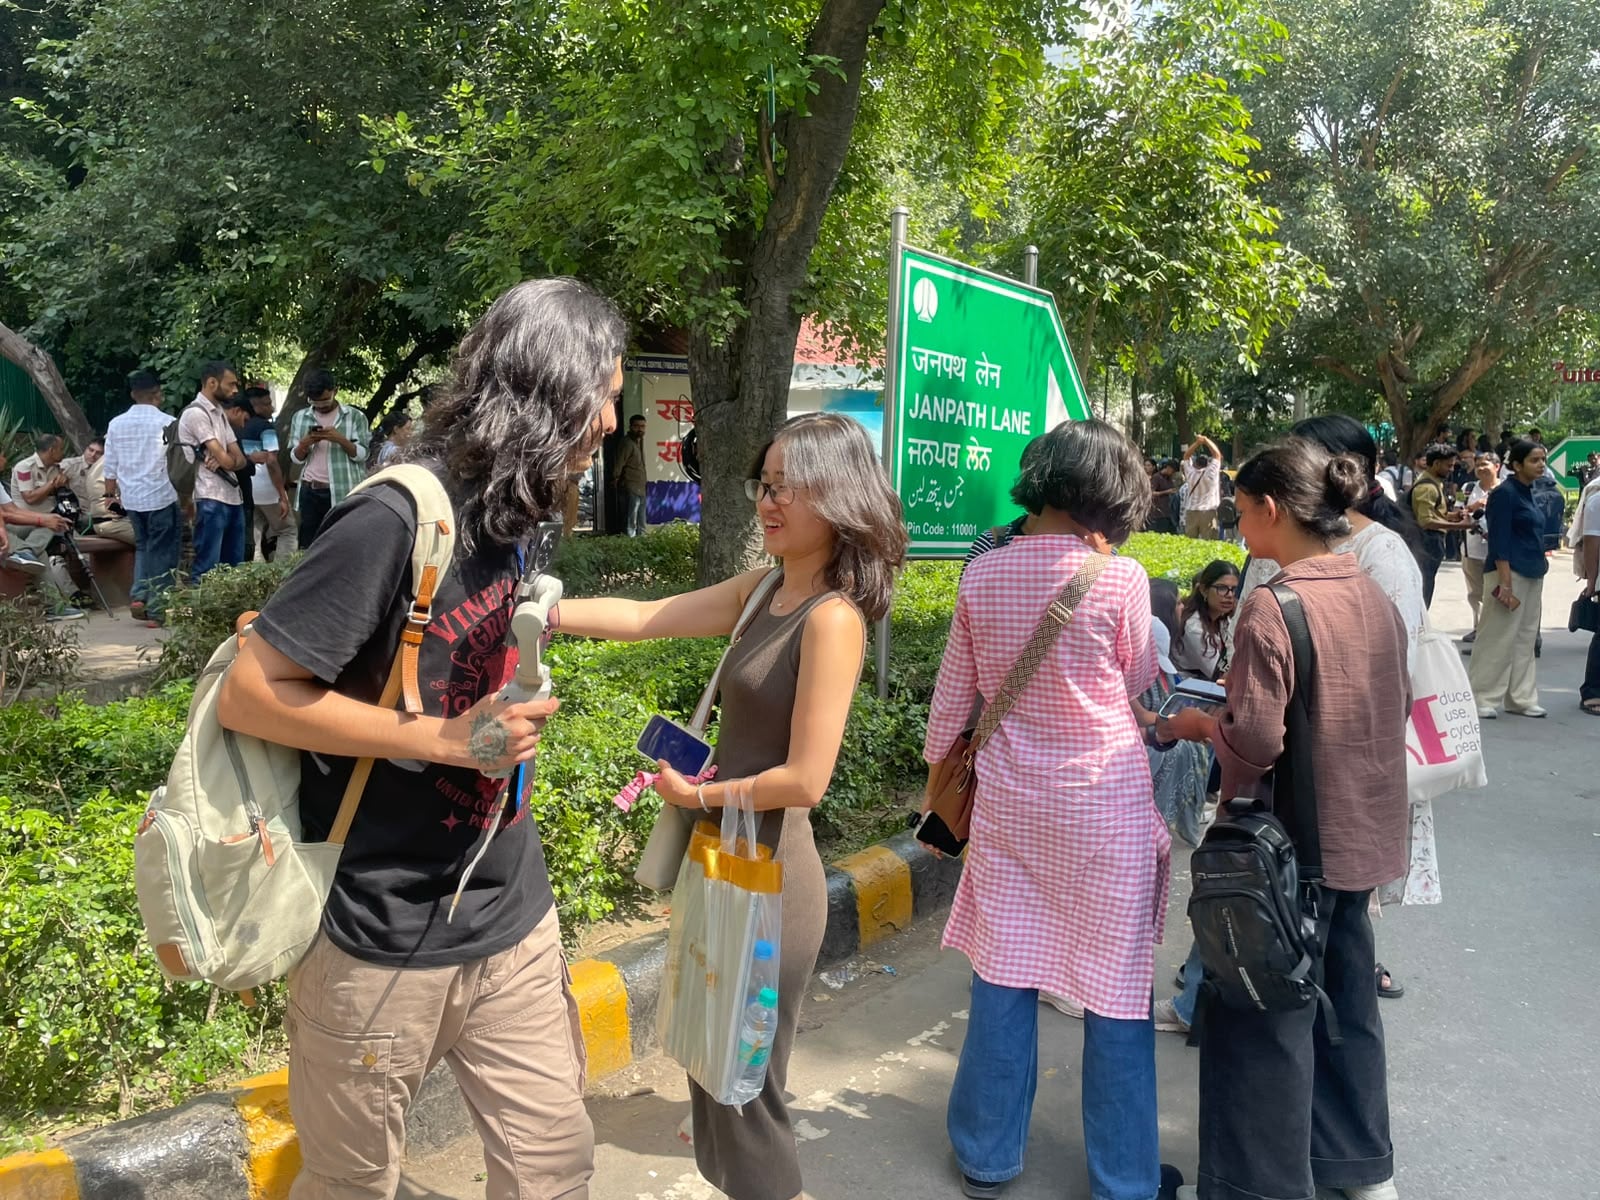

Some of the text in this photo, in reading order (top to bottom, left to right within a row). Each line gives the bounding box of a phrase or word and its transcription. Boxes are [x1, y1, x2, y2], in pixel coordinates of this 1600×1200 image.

[911, 346, 1002, 389] जनपथ लेन
[909, 392, 1031, 435] JANPATH LANE
[907, 521, 921, 535] Pin
[922, 521, 945, 535] Code
[951, 523, 977, 536] 110001
[1440, 690, 1472, 706] duce
[1445, 707, 1470, 722] use.
[1450, 721, 1480, 740] cycle
